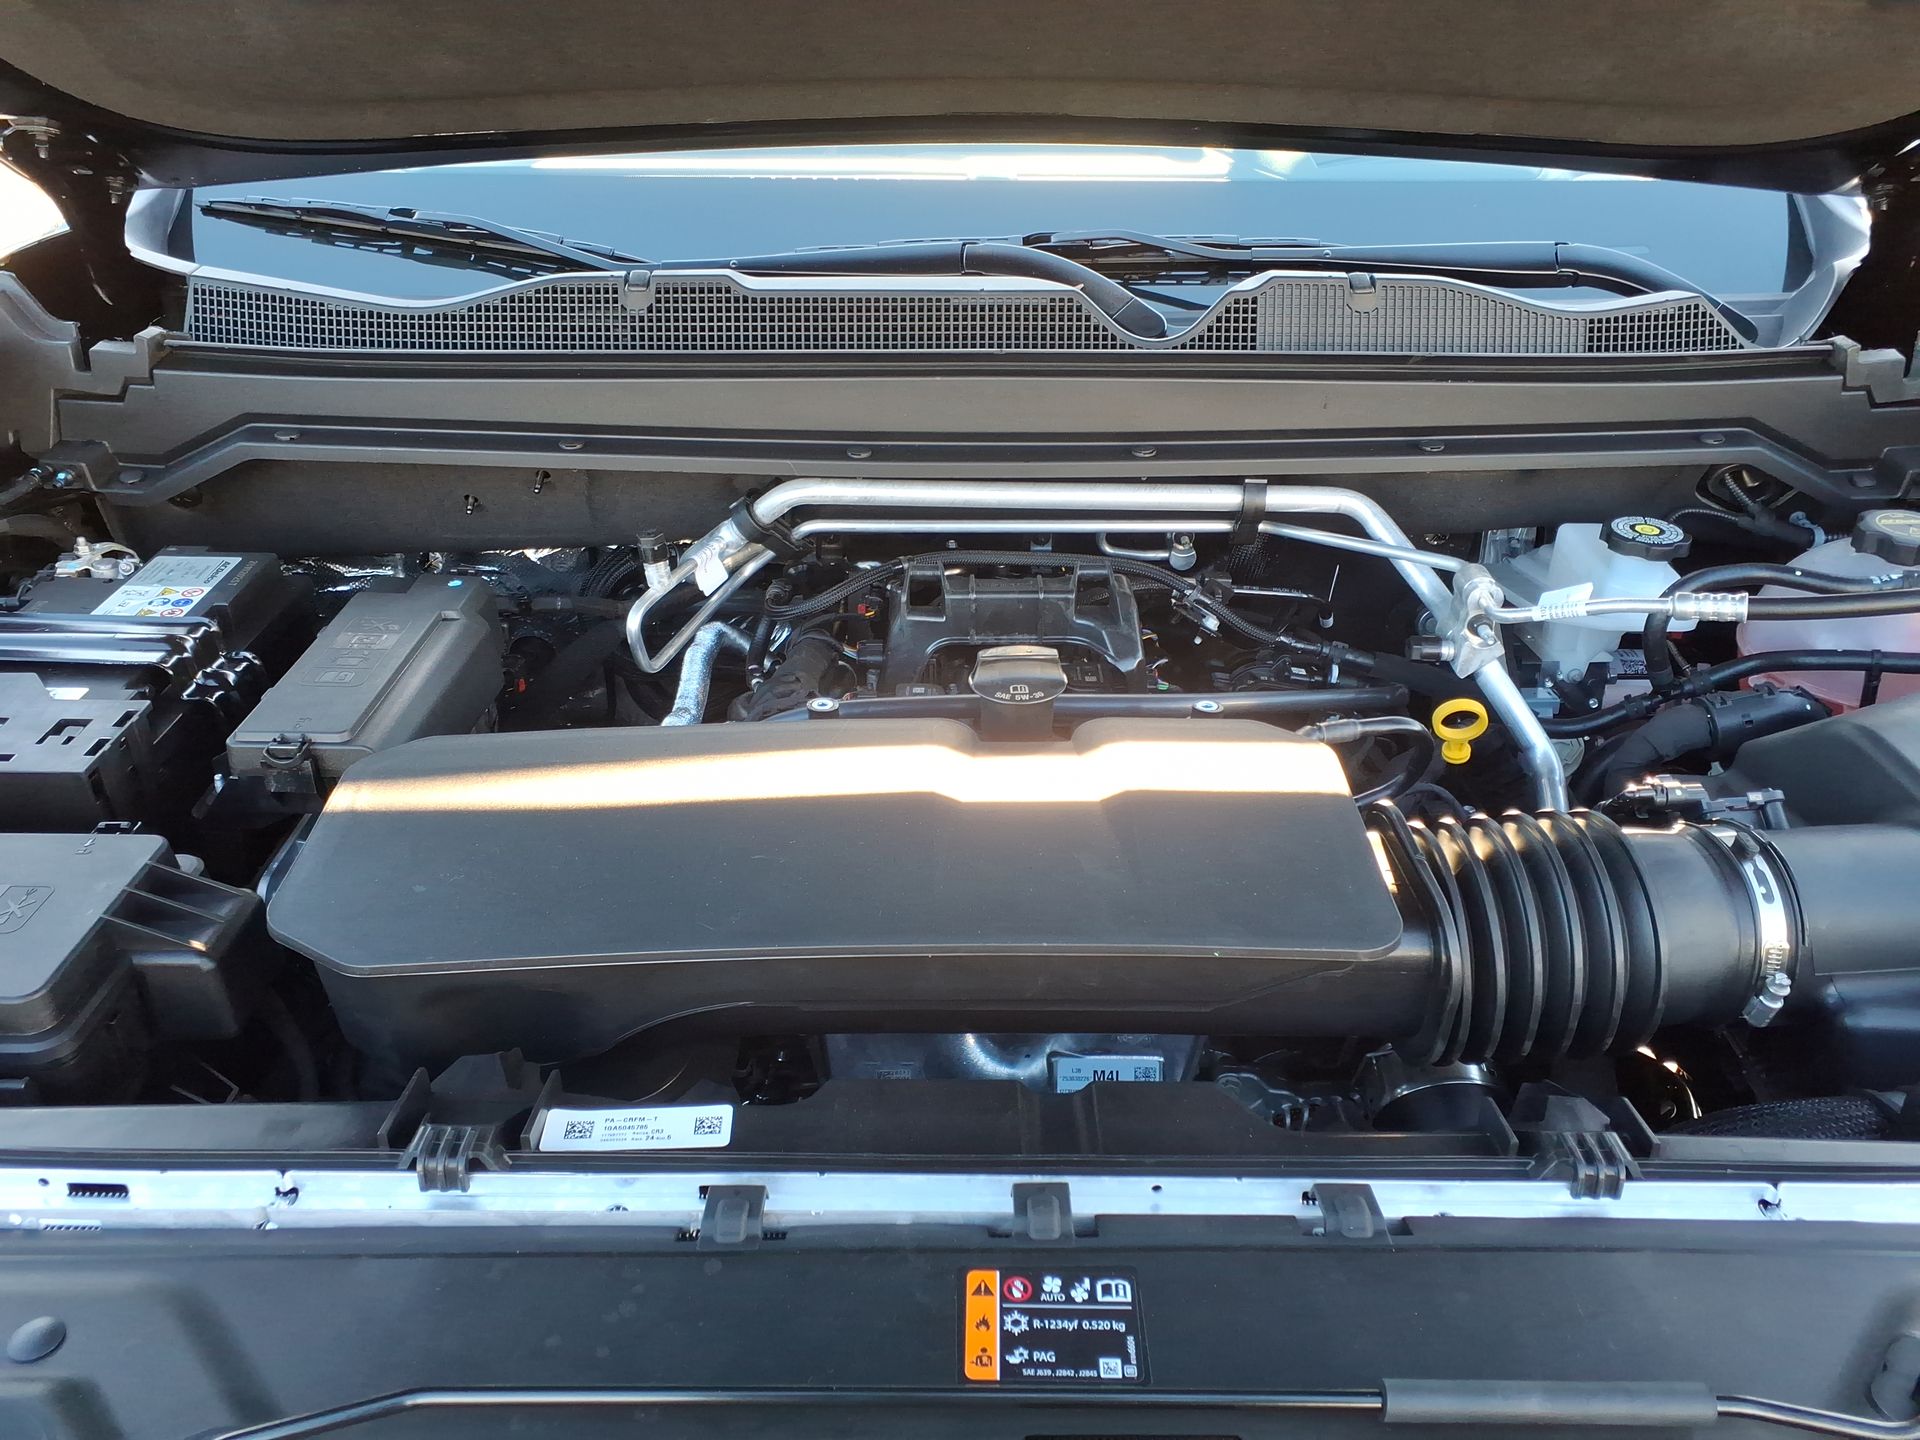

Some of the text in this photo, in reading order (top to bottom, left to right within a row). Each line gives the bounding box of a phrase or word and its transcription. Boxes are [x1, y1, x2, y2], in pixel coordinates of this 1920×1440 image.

[1040, 1293, 1066, 1302] AUTO
[1032, 1319, 1126, 1333] R-1234yf 0.520 kg
[1033, 1351, 1056, 1363] PAG
